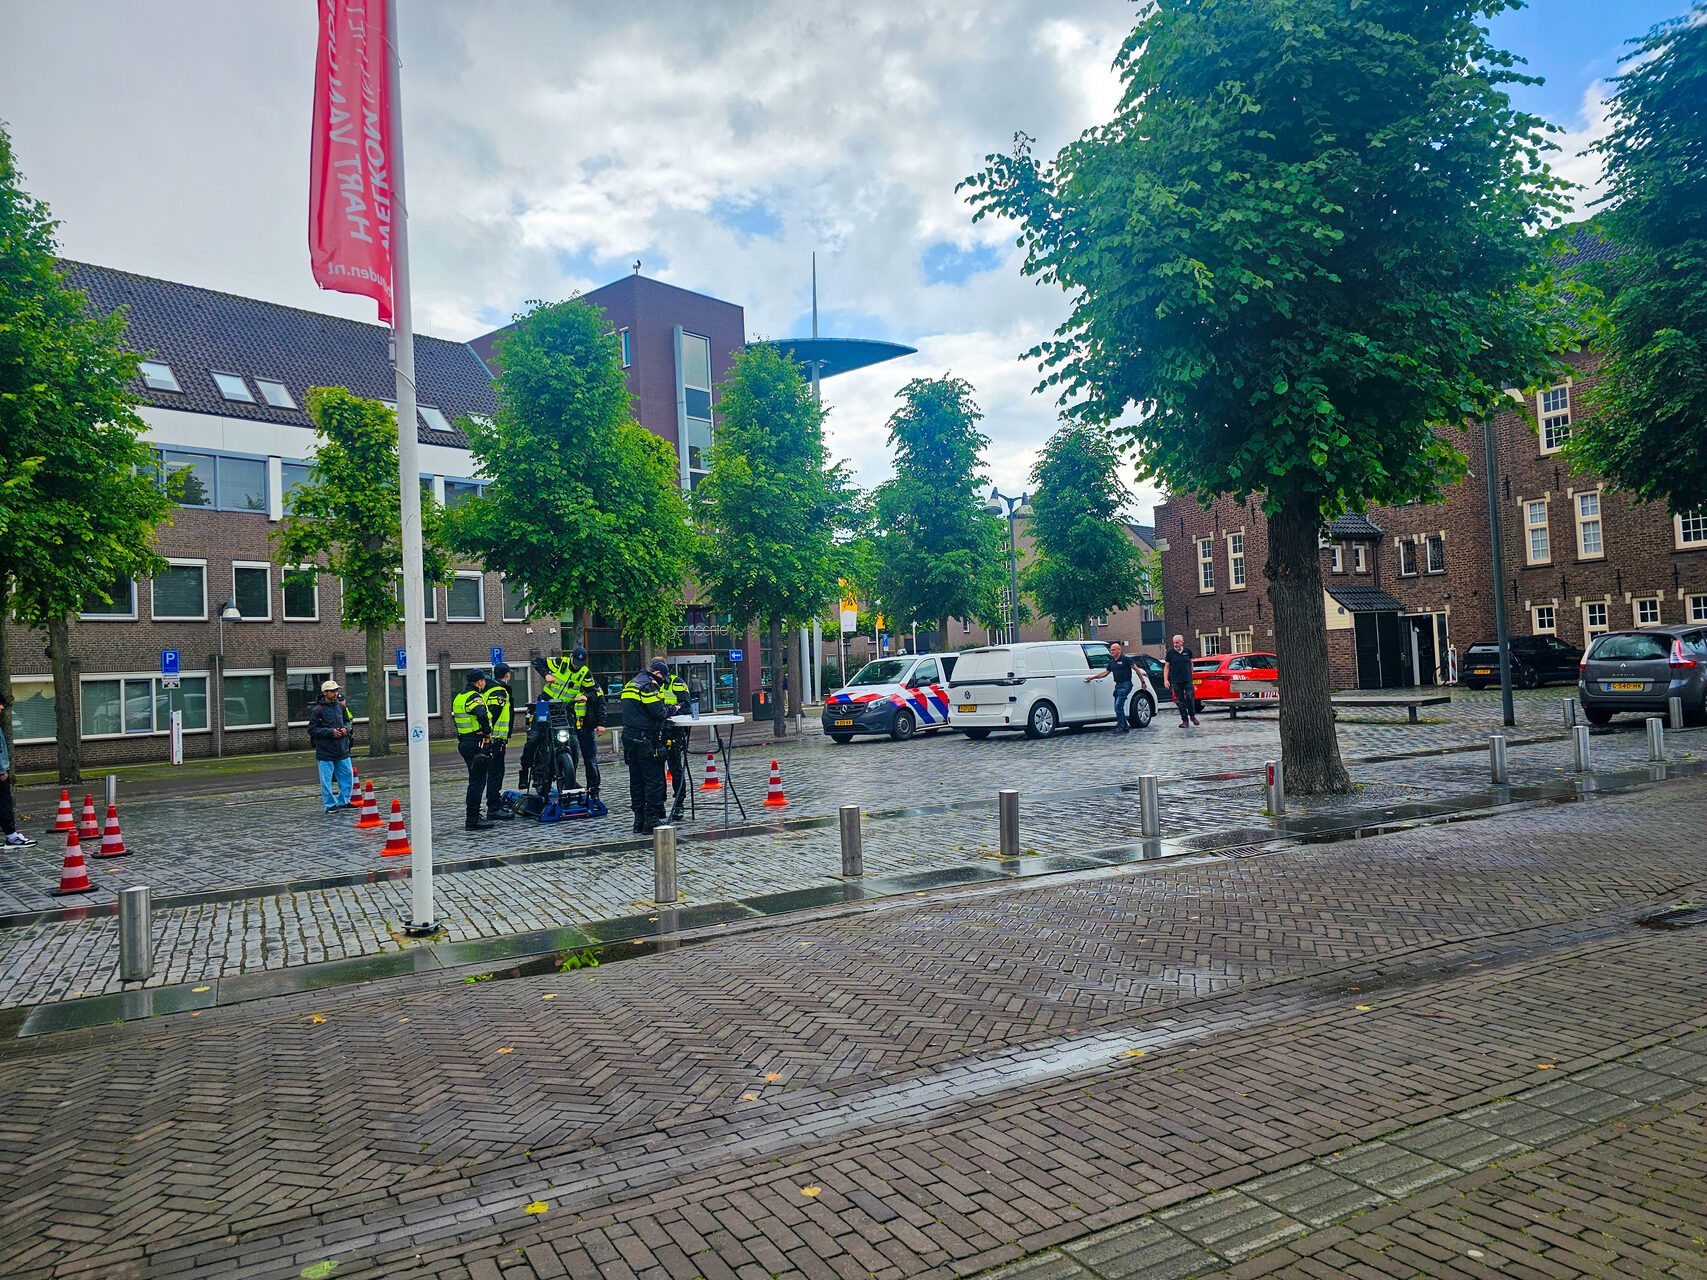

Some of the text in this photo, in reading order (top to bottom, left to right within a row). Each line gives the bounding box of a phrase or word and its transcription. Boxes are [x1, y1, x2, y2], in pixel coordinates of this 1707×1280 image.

[400, 651, 406, 660] P
[494, 649, 500, 657] P
[166, 653, 175, 664] P
